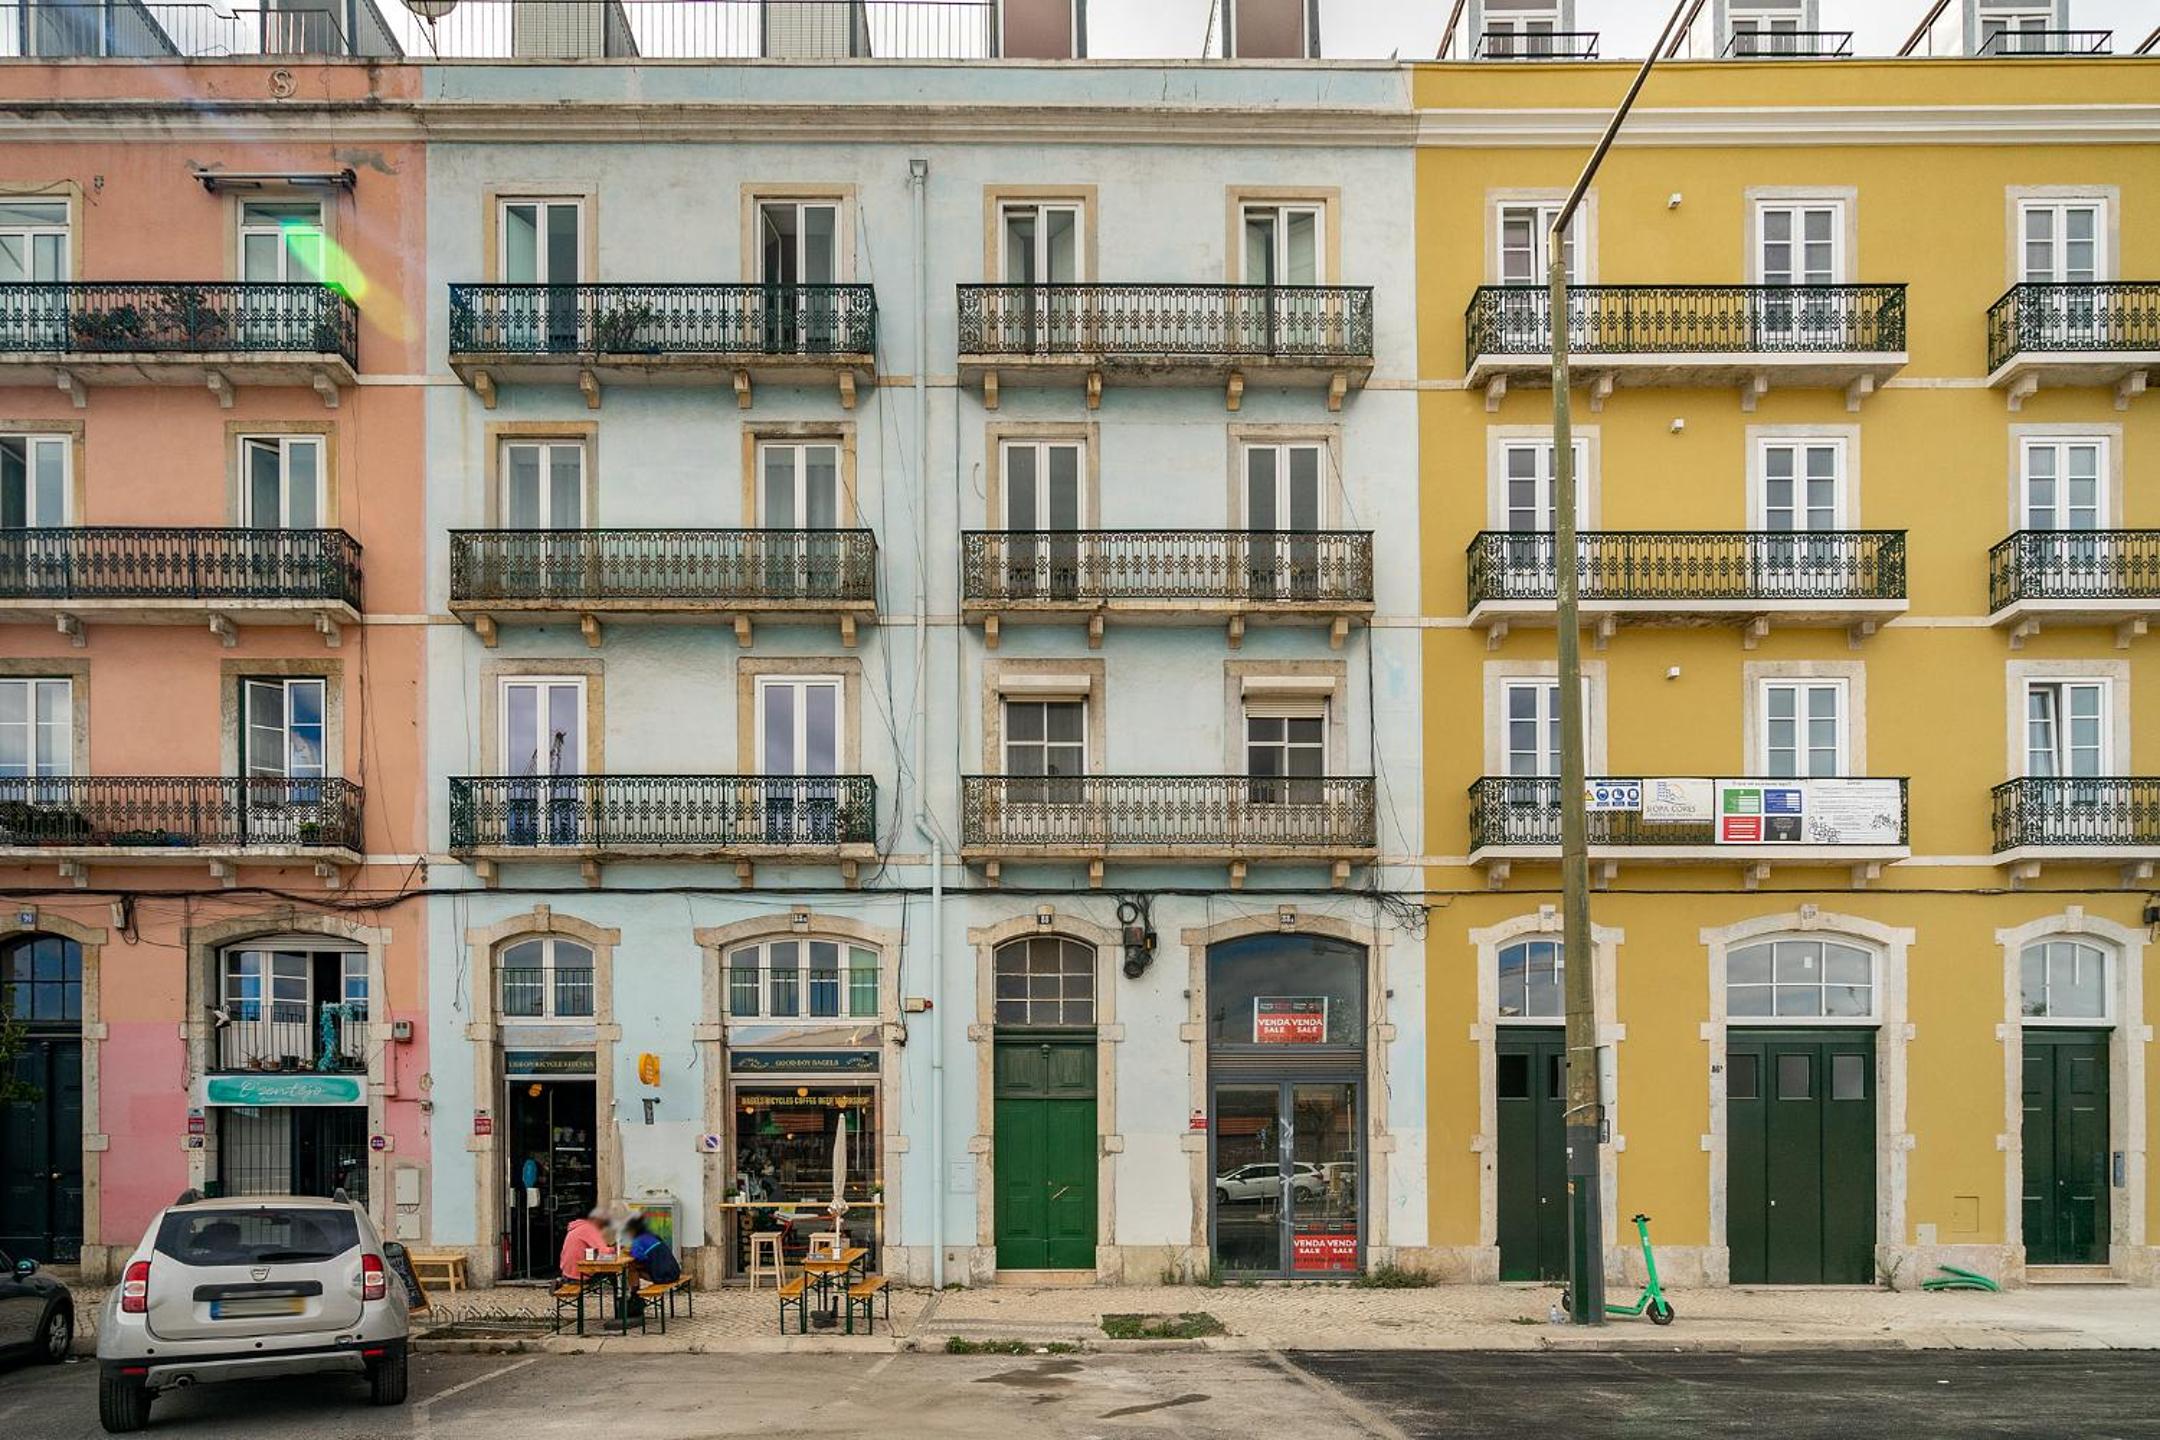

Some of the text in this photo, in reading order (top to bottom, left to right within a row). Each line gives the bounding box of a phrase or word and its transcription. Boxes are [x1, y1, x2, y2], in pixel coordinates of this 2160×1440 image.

[1258, 1018, 1323, 1026] VENDA VENDA
[795, 1096, 817, 1105] COFFEE
[1293, 1239, 1358, 1247] VENDA VENDA
